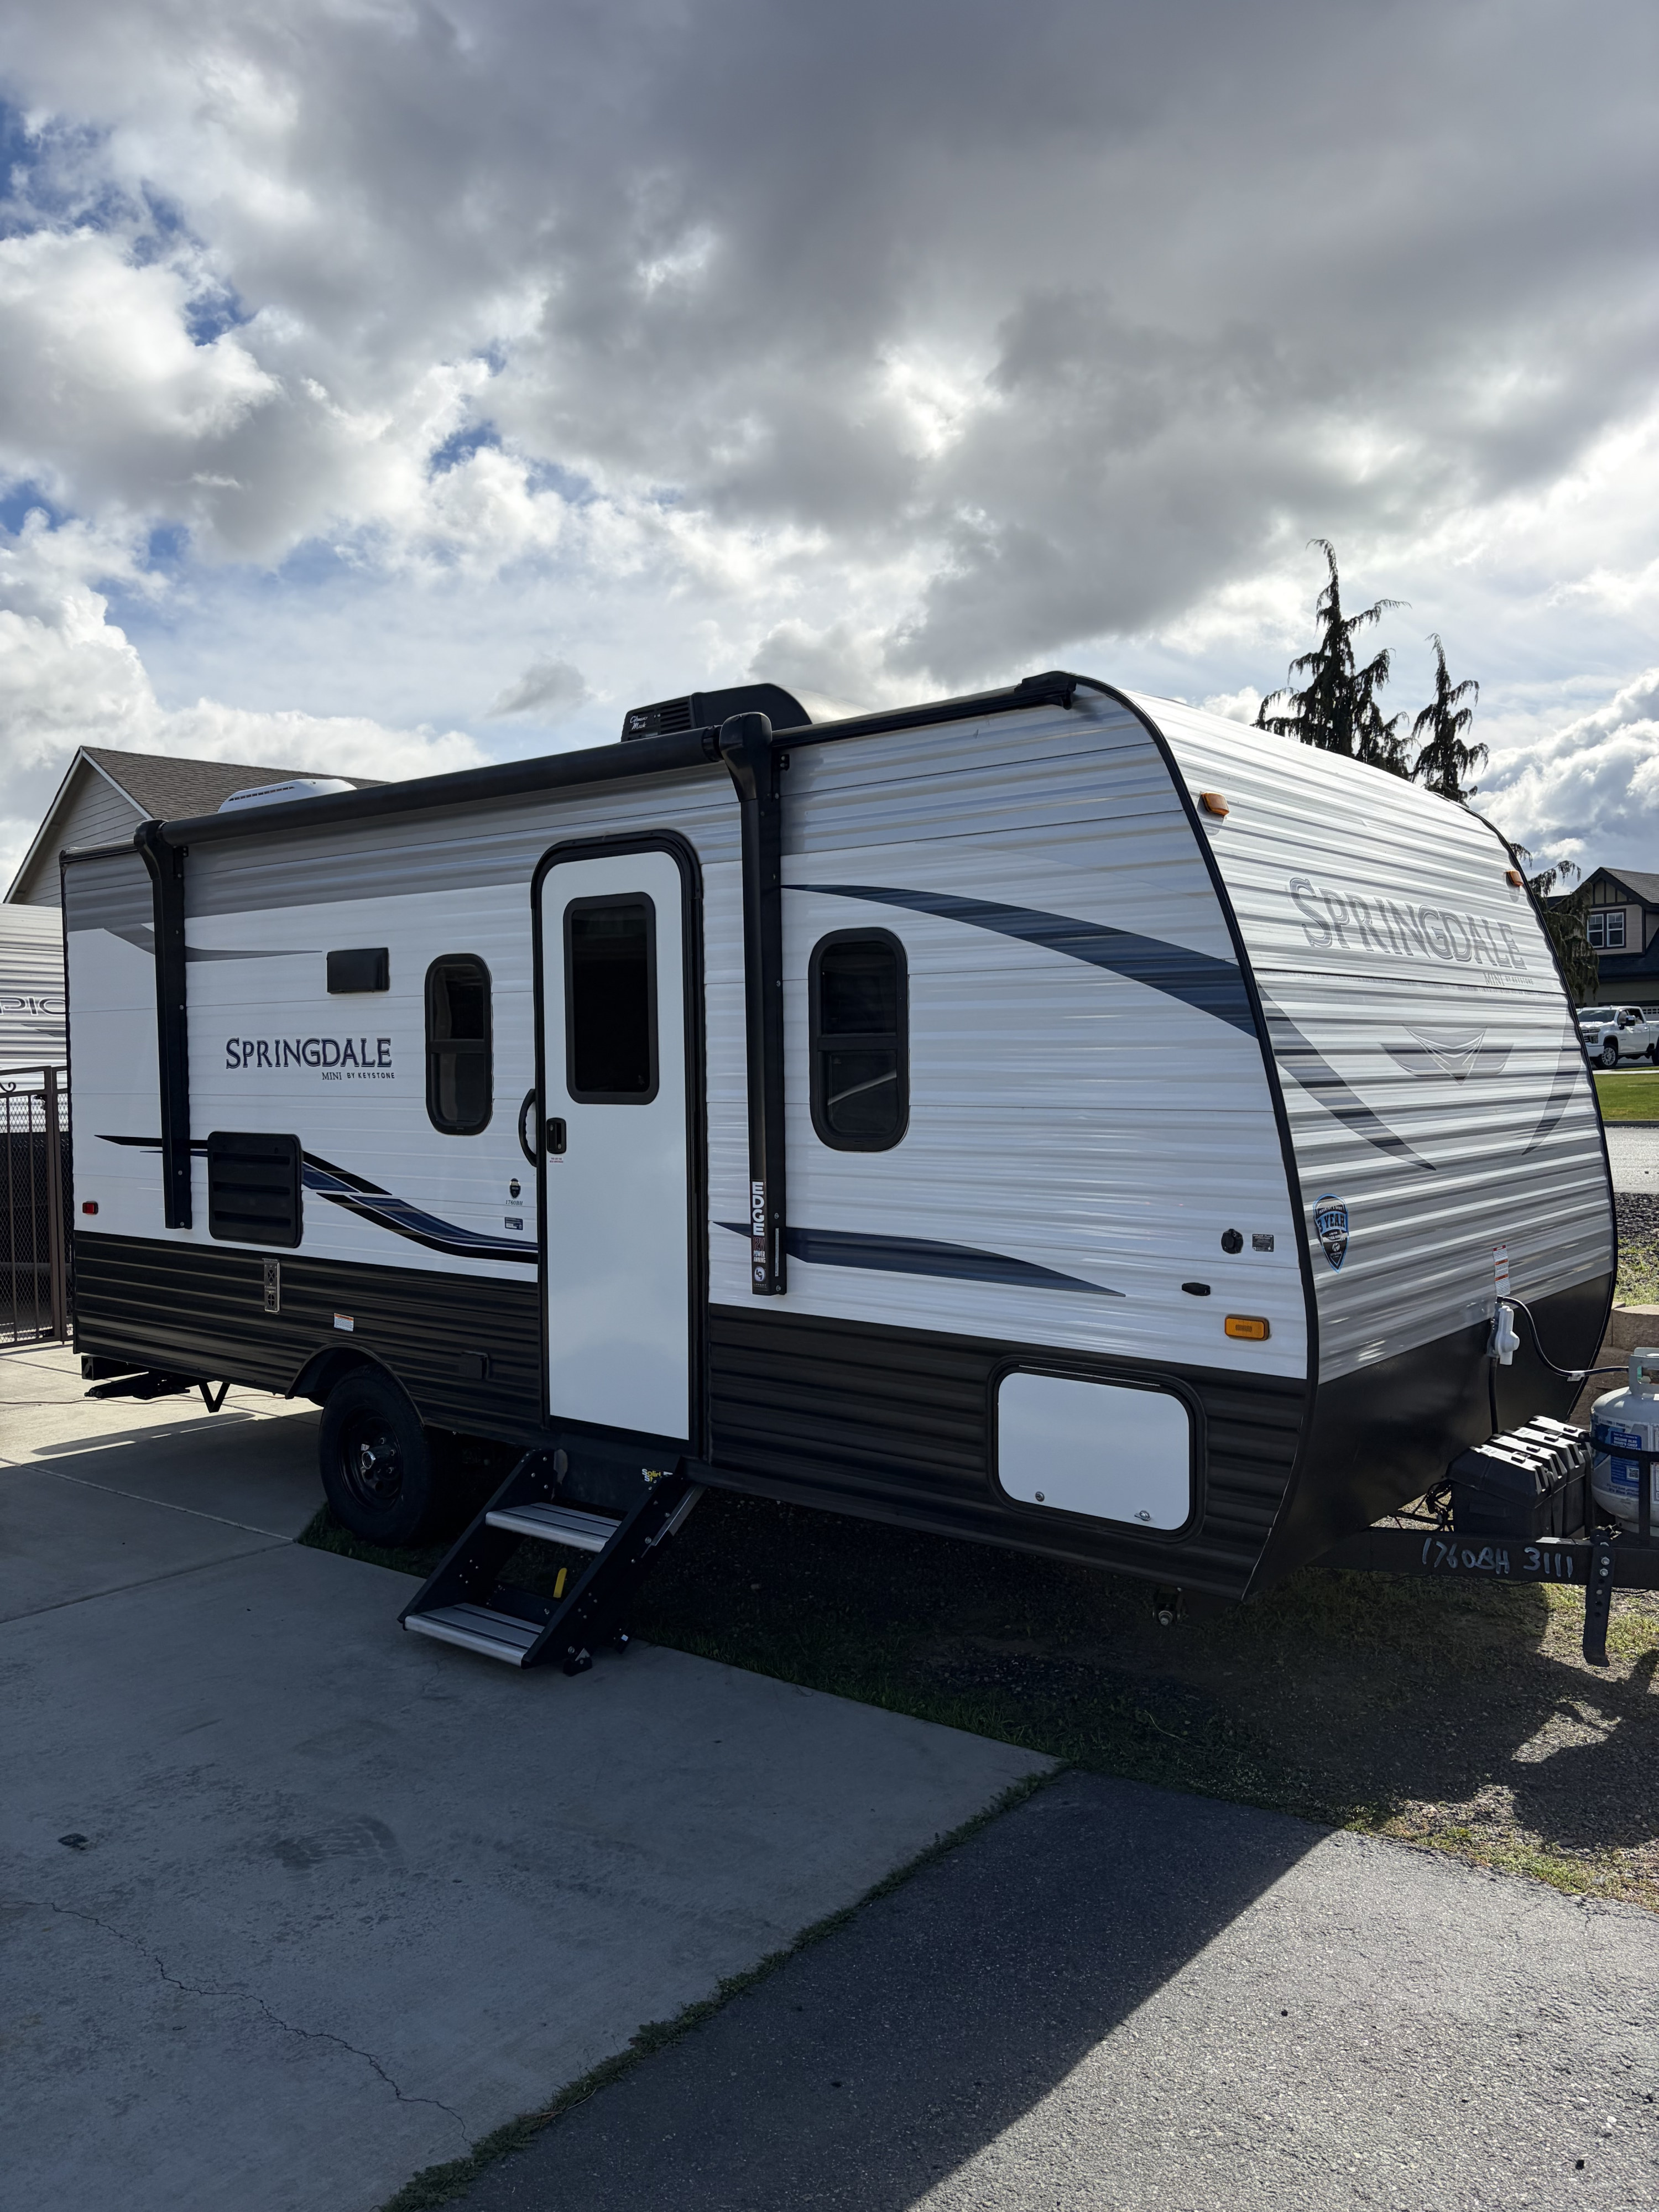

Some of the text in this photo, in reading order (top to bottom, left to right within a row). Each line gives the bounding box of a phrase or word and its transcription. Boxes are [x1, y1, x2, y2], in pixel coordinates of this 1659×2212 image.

[1289, 877, 1527, 970] SPRINGDALE
[1483, 972, 1505, 986] MINI
[226, 1037, 392, 1068] SPRINGDALE
[752, 1181, 765, 1236] EDGE
[1317, 1213, 1345, 1233] 3 YEAR
[1523, 1547, 1573, 1578] 3111
